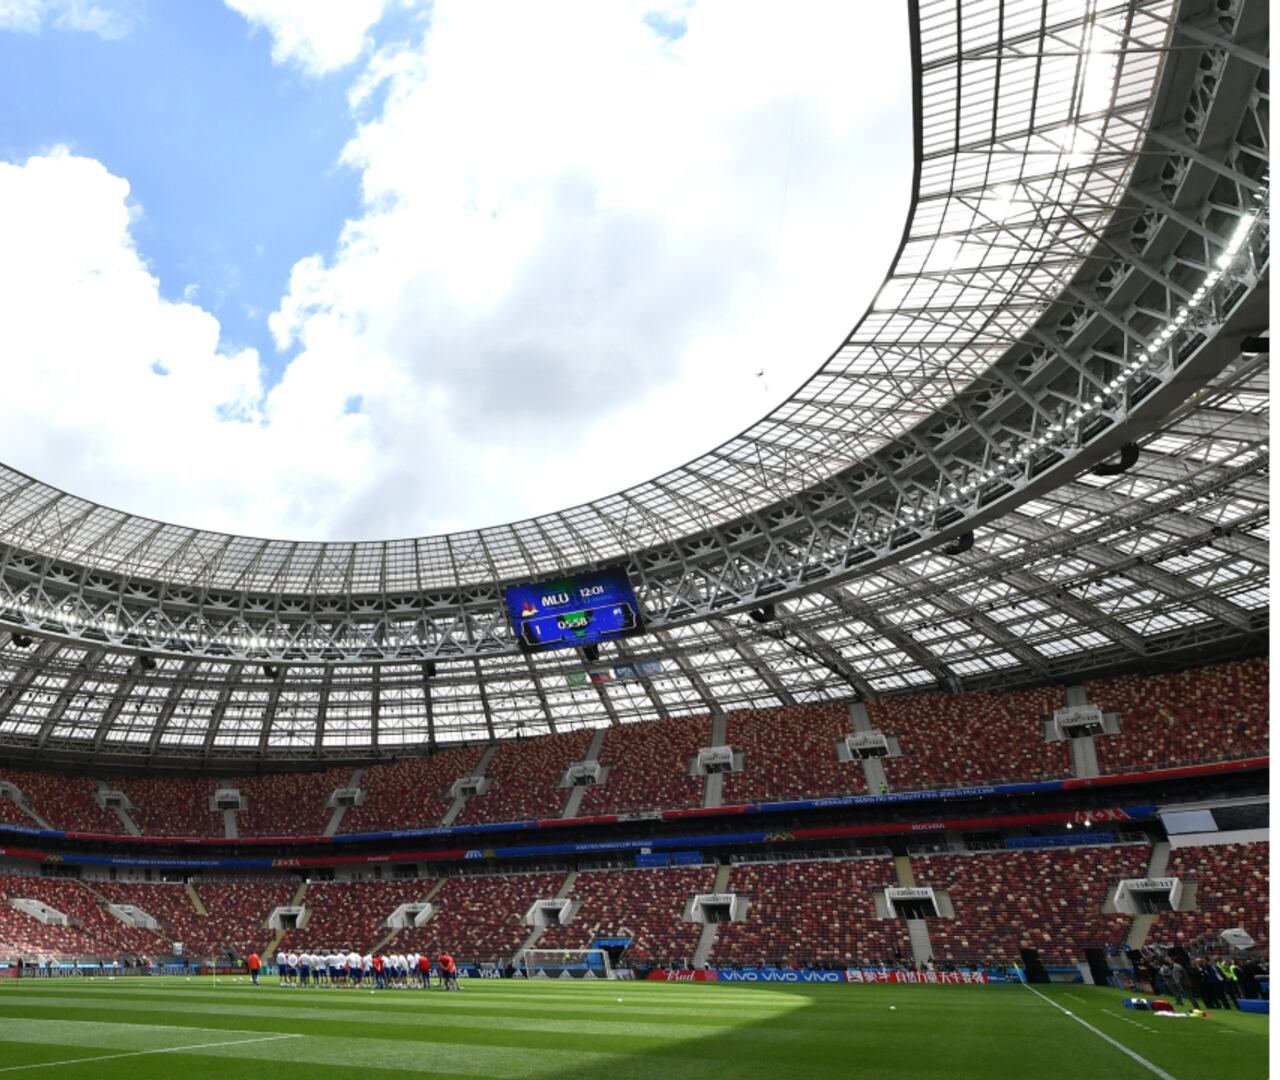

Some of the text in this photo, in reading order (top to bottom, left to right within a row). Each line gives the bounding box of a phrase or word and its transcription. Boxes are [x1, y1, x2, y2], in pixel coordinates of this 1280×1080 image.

[477, 968, 500, 979] VISA
[662, 967, 695, 981] Bud
[723, 971, 757, 981] vivo
[761, 971, 797, 982] vivo
[803, 971, 839, 982] vivo
